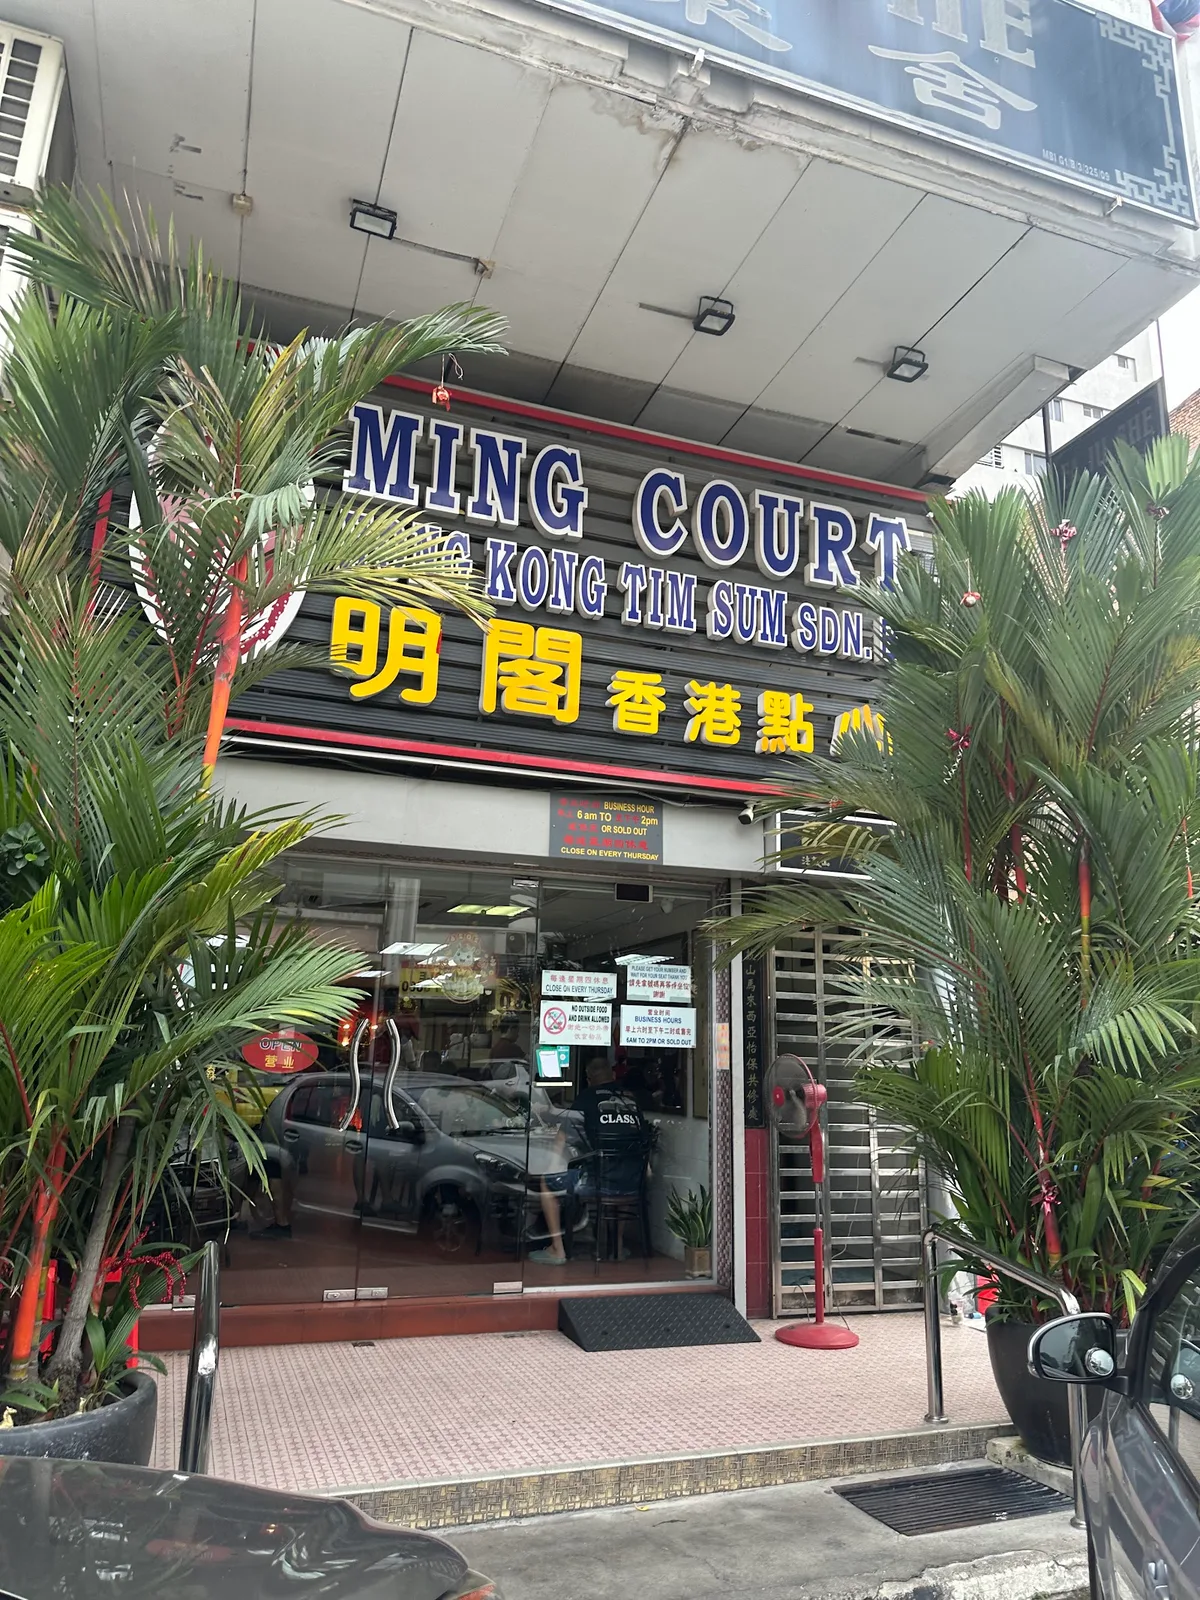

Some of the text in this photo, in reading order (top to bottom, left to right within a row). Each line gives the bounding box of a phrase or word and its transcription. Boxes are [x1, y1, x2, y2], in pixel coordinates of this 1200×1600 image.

[343, 402, 909, 594] MING COURT
[485, 537, 606, 619] KONG
[619, 561, 697, 635] TIM
[706, 579, 788, 649] SUM
[792, 602, 873, 663] SDN.
[330, 597, 582, 726] 明閣
[604, 801, 636, 812] BUSINESS
[637, 804, 655, 814] HOUR
[577, 810, 583, 819] 6
[584, 812, 598, 820] am
[599, 812, 612, 822] TO
[641, 816, 659, 826] 2pm
[601, 825, 613, 833] OR
[613, 825, 632, 835] SOLD
[633, 828, 647, 836] OUT
[560, 847, 585, 855] CLOSE
[599, 850, 622, 858] EVERY
[623, 852, 659, 861] THURSDAY
[546, 984, 562, 992] CLOSE
[571, 985, 588, 993] EVERY
[588, 986, 613, 994] THURSDAY
[578, 1005, 596, 1013] OUTSIDE
[260, 1037, 302, 1052] OPEN
